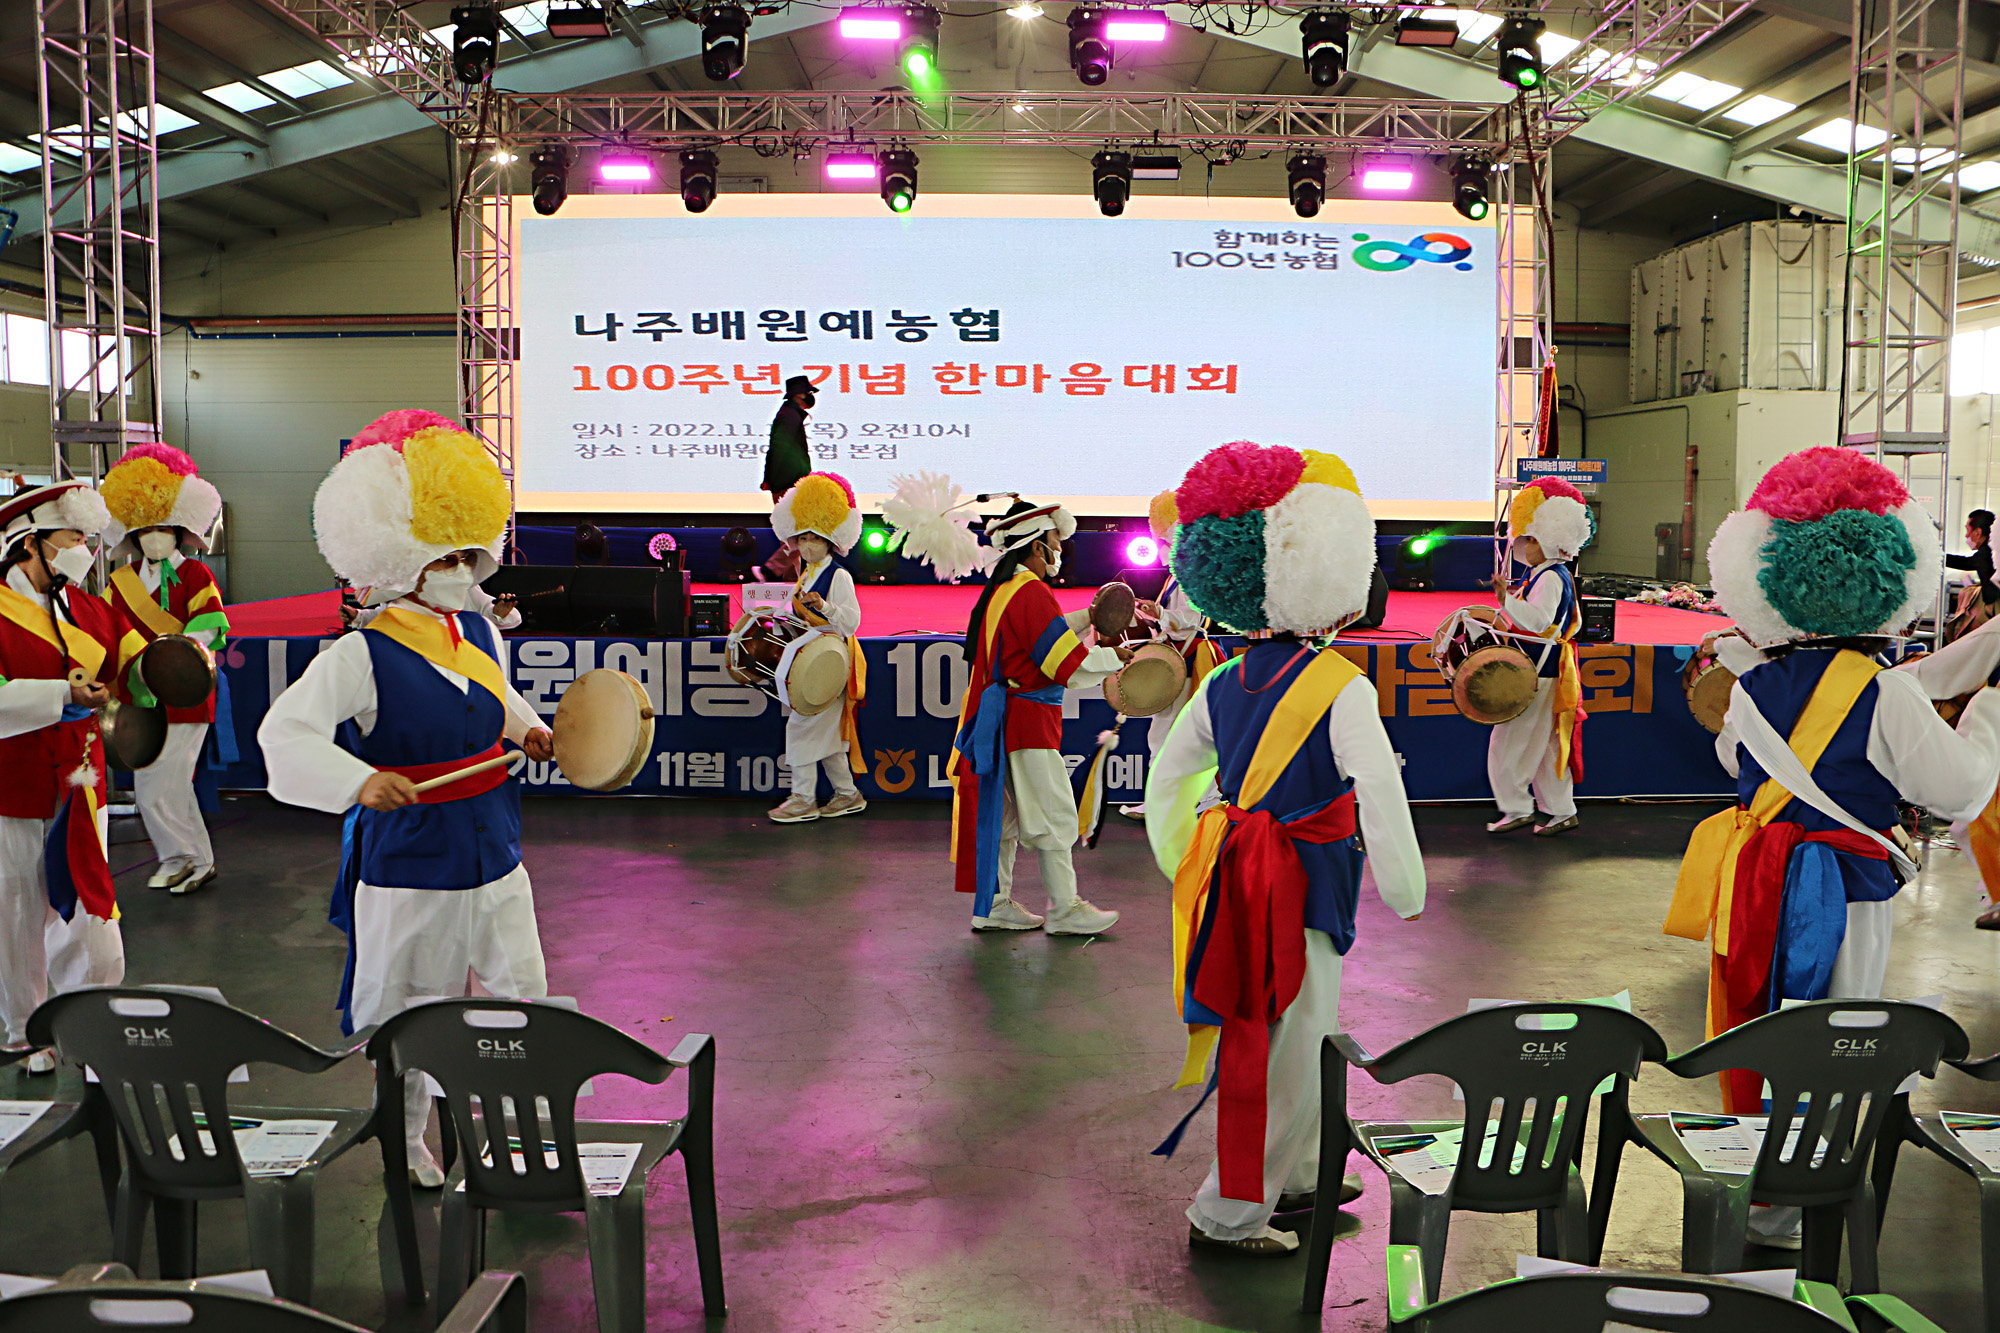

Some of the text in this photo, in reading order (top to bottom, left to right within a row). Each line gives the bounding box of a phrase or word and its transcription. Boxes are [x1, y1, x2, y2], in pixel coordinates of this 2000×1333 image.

[1213, 229, 1340, 250] 함께하는
[1171, 251, 1339, 270] 100년 농협
[574, 307, 1001, 343] 나주배원예농협
[572, 361, 1238, 396] 100주년 기념 한마음대회
[571, 422, 623, 440] 일시
[858, 421, 972, 440] 오전10시
[574, 443, 627, 460] 장소
[651, 443, 839, 461] 나주배원협
[847, 443, 898, 461] 본점
[656, 751, 725, 788] 11월
[124, 1026, 171, 1039] CLK
[477, 1039, 526, 1051] CLK
[1522, 1041, 1569, 1053] CLK
[1834, 1038, 1880, 1050] CLK
